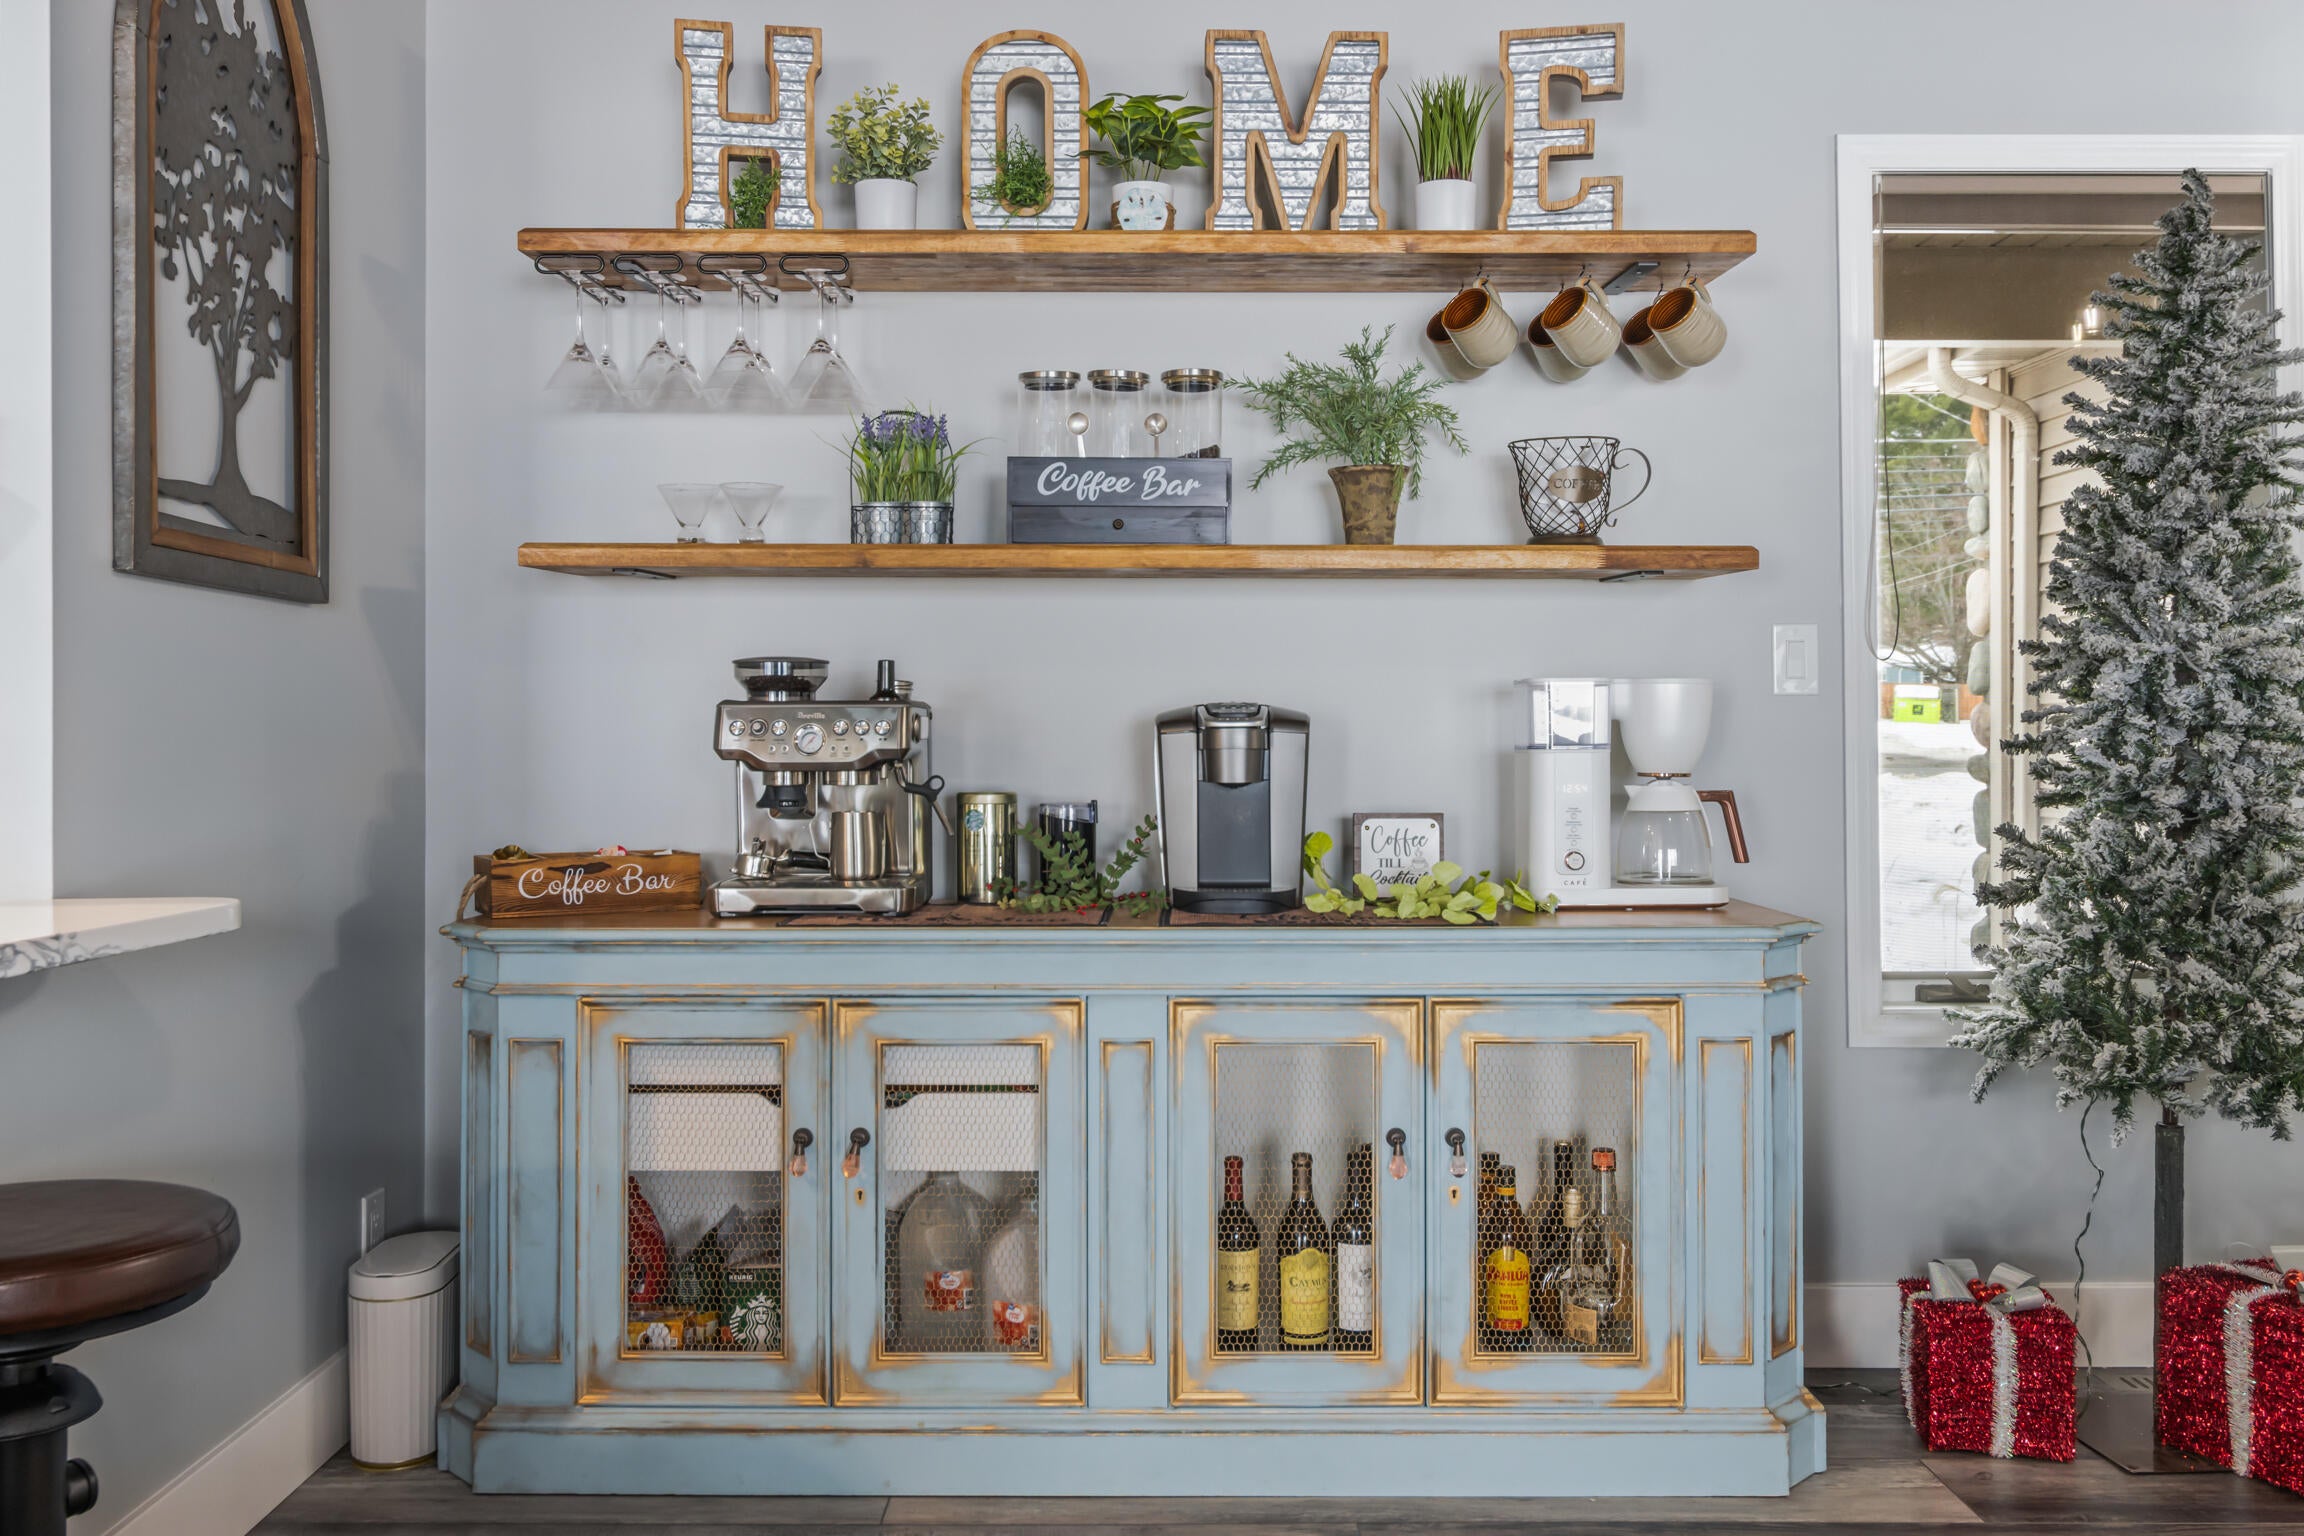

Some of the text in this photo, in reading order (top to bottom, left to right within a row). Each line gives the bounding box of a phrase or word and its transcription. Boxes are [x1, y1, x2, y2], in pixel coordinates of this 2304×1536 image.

[1037, 461, 1202, 501] Coffee Bar
[1371, 825, 1429, 857] Coffee
[1377, 857, 1405, 868] TILL
[518, 863, 676, 905] Coffee Bar
[1563, 877, 1587, 886] CAFÉ
